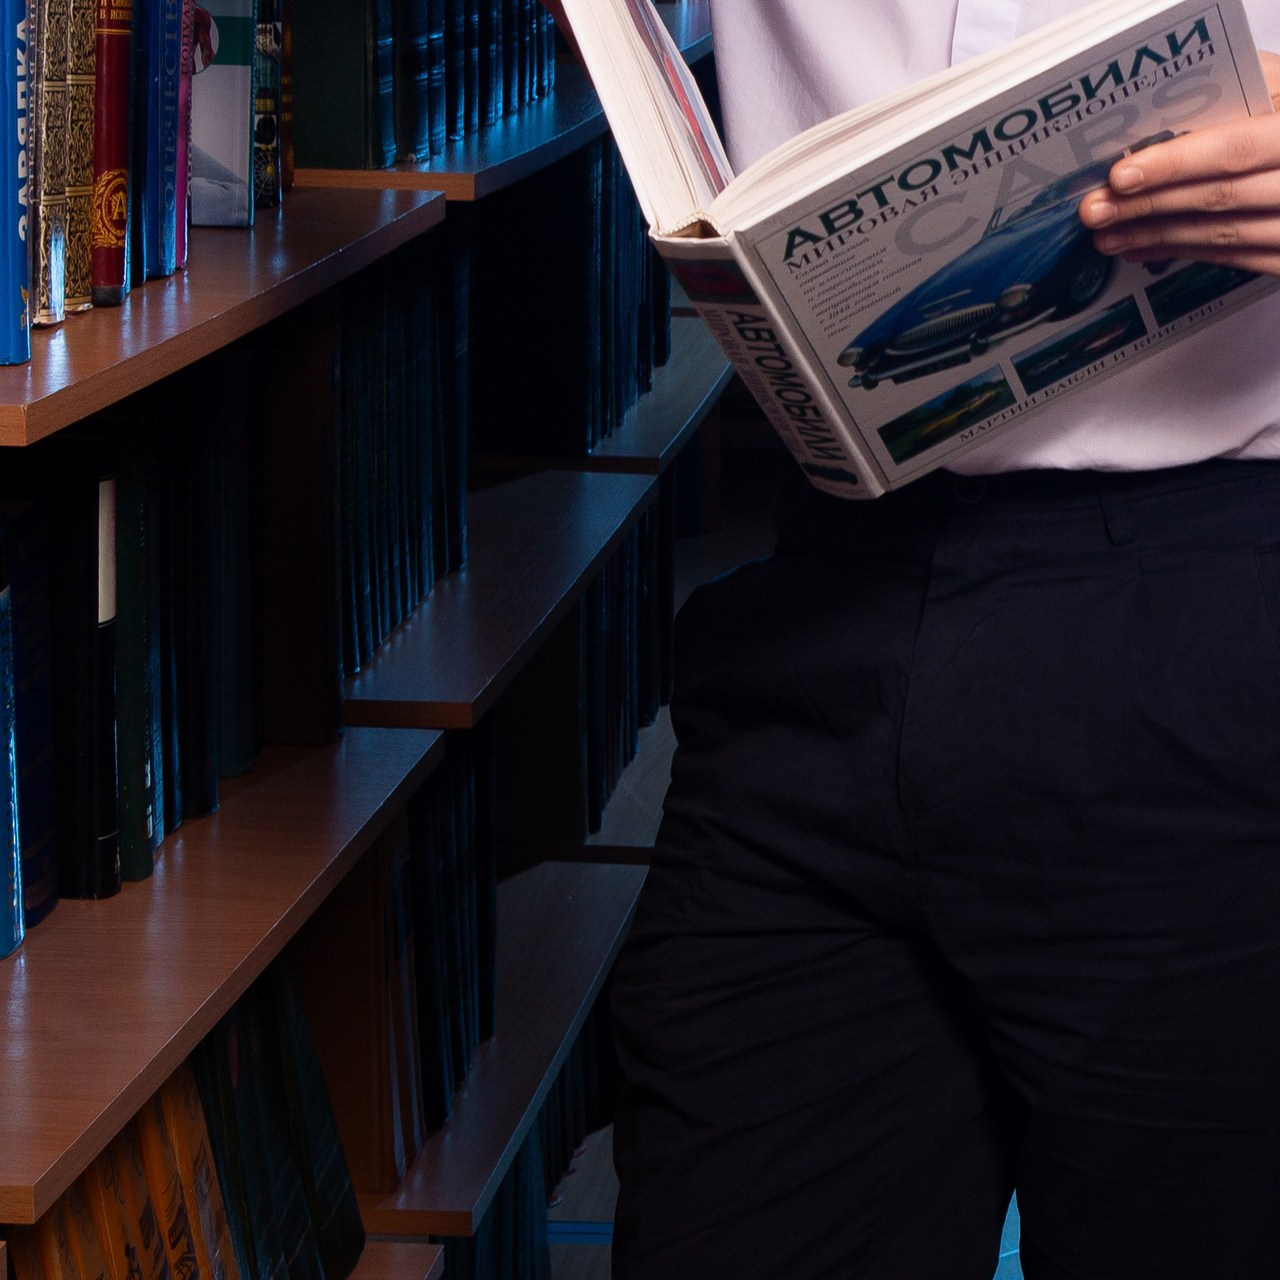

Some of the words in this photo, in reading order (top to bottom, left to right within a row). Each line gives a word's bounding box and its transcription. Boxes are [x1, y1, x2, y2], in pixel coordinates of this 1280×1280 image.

[781, 16, 1212, 264] АВТОМОБИЛИ
[785, 183, 941, 274] МИРОВАЯ
[950, 42, 1217, 187] ЭНЦИКЛОПЕДИЯ
[894, 63, 1223, 257] CARS
[725, 309, 847, 462] АВТОМОБИЛИ
